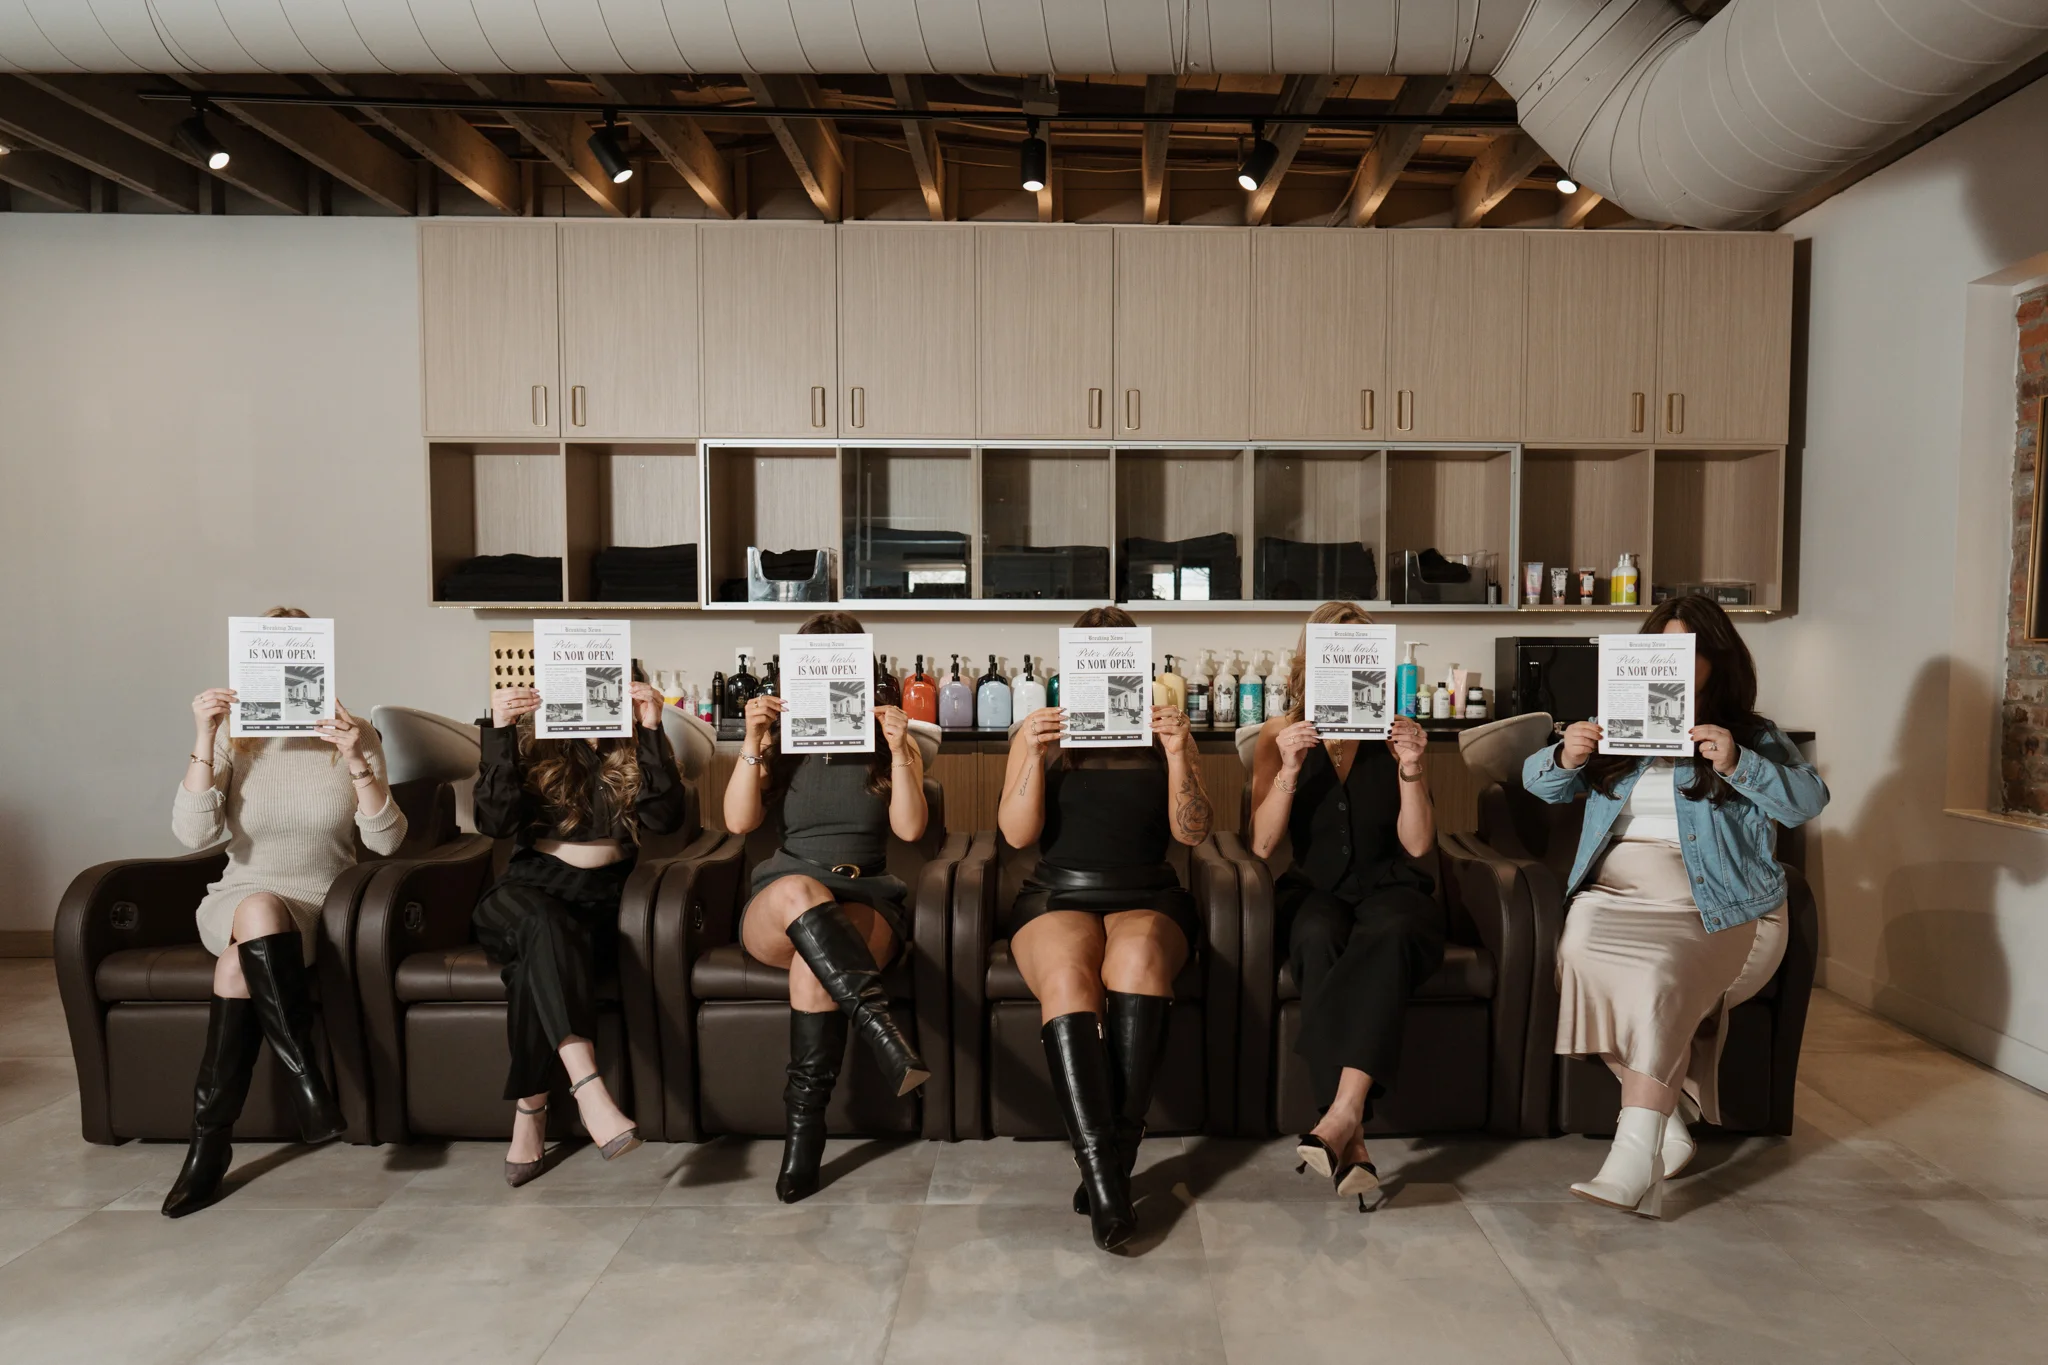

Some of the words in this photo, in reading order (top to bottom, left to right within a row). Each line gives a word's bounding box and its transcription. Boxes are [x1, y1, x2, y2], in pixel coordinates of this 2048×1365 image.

[248, 638, 276, 647] Peter
[280, 637, 314, 648] Marks
[552, 640, 577, 649] Peter
[581, 639, 612, 649] Marks
[1076, 648, 1100, 657] Peter
[1103, 647, 1134, 657] Marks
[1322, 643, 1345, 653] Peter
[1348, 643, 1378, 653] Marks
[249, 649, 259, 659] IS
[262, 649, 284, 659] NOW
[287, 650, 316, 660] OPEN!
[553, 651, 562, 661] IS
[565, 651, 585, 661] NOW
[588, 651, 614, 661] OPEN!
[797, 654, 821, 664] Peter
[825, 653, 856, 664] Marks
[1322, 654, 1331, 664] IS
[1333, 654, 1352, 664] NOW
[1355, 655, 1379, 664] OPEN!
[1616, 654, 1640, 664] Peter
[1645, 653, 1676, 664] Marks
[1077, 660, 1085, 669] IS
[1088, 659, 1107, 669] NOW
[1110, 659, 1135, 669] OPEN!
[798, 666, 806, 675] IS
[809, 666, 829, 675] NOW
[832, 666, 857, 675] OPEN!
[1617, 666, 1625, 676] IS
[1628, 666, 1648, 676] NOW
[1651, 666, 1678, 676] OPEN!
